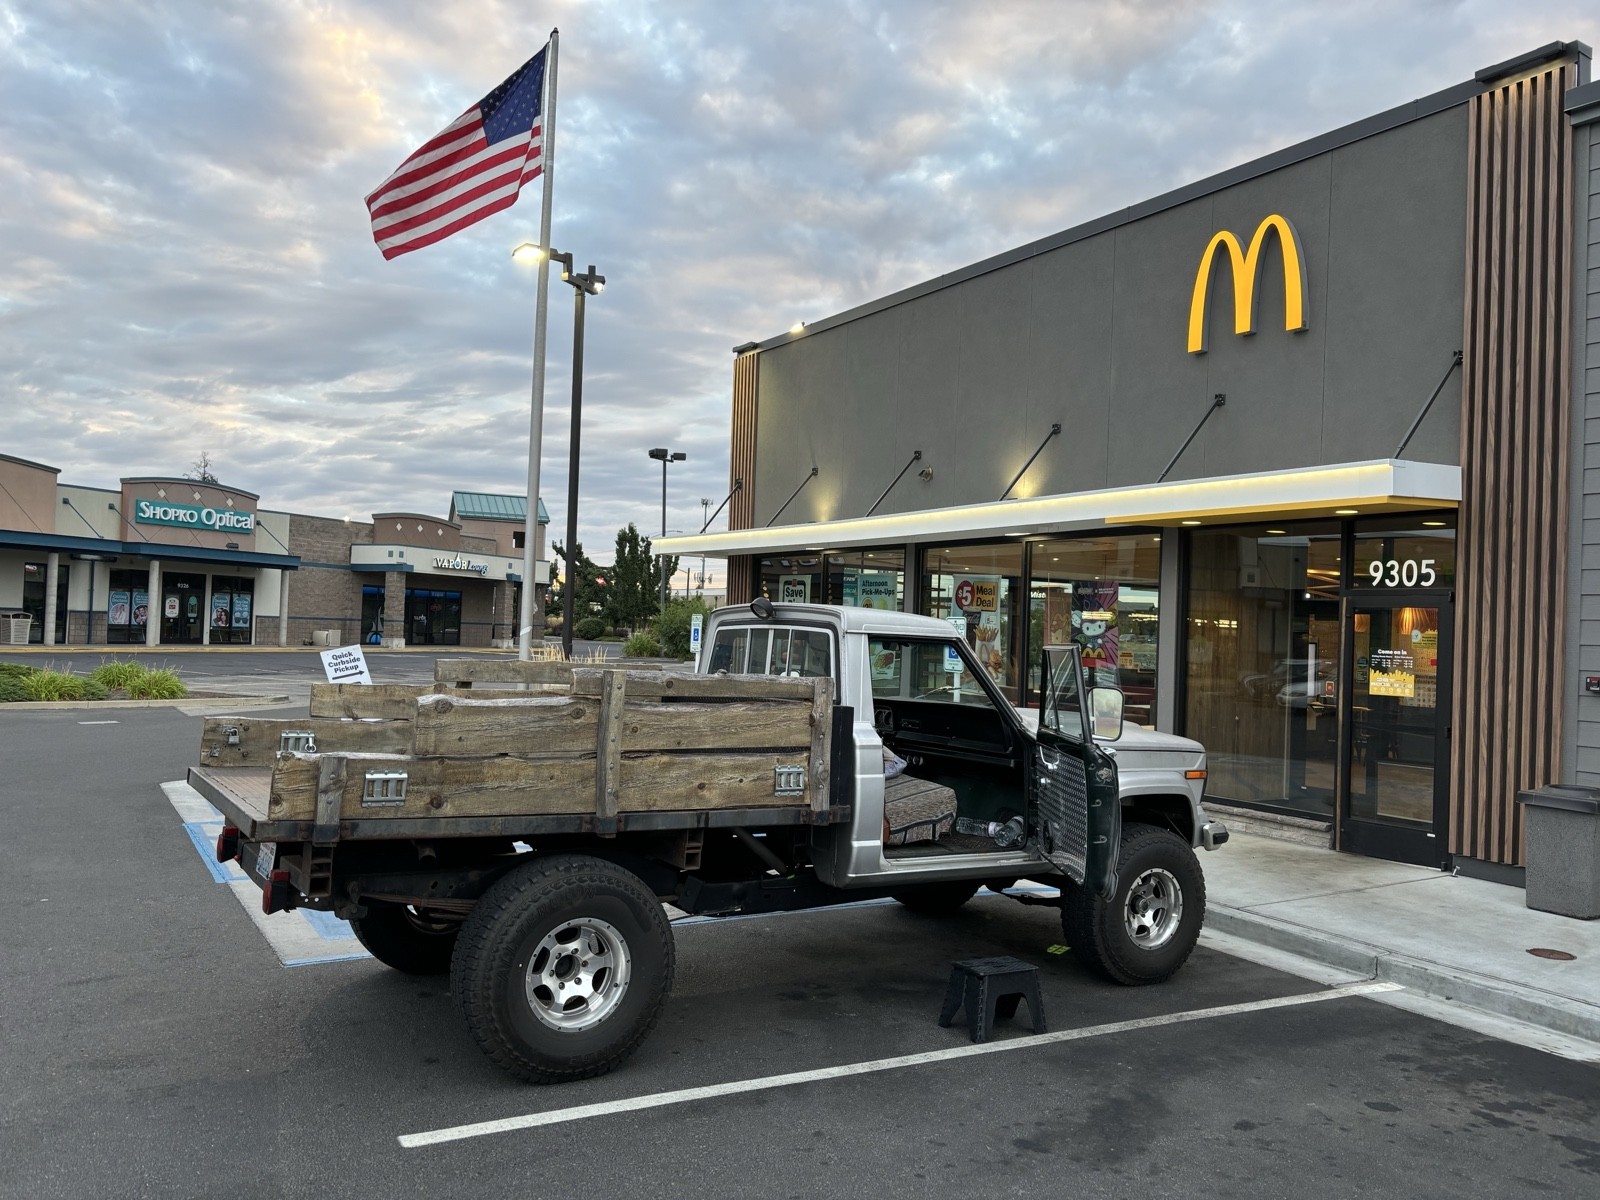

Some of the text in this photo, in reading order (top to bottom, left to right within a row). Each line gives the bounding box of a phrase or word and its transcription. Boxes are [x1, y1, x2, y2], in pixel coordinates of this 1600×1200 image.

[200, 508, 255, 530] Optical
[433, 551, 467, 570] VAPOR
[1369, 559, 1436, 588] 9305
[861, 580, 888, 588] Afternoon
[785, 586, 804, 598] Save
[861, 588, 896, 597] Pick-Me-Ups
[958, 586, 972, 606] $5
[975, 585, 996, 596] Meal
[975, 597, 995, 608] Deal
[331, 651, 354, 661] Quick
[328, 656, 361, 668] Curbside
[333, 664, 359, 674] Pickup
